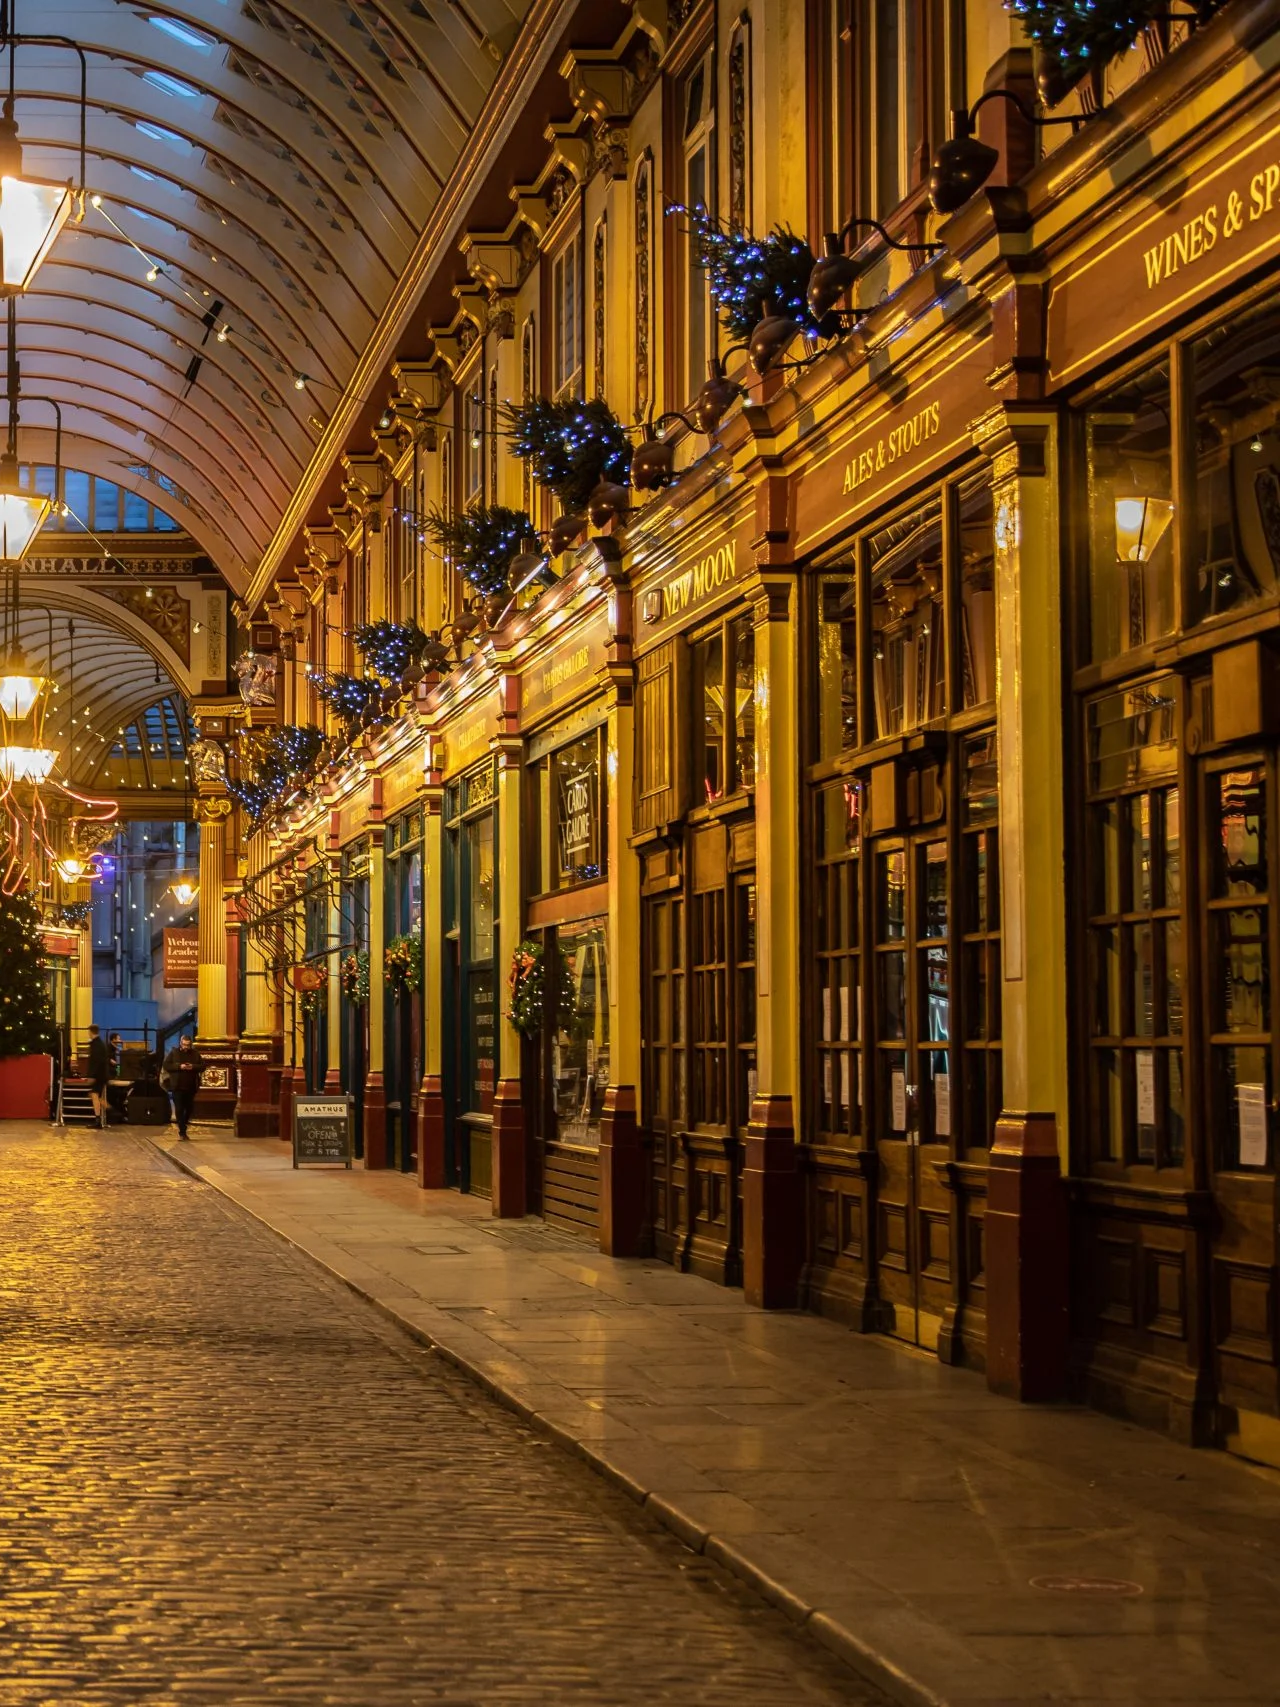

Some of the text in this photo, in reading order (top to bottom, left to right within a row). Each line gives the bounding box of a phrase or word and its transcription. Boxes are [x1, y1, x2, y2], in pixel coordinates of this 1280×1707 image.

[1143, 164, 1280, 289] WINES & SP
[842, 400, 940, 496] ALES & STOUTS
[663, 539, 736, 620] NEW MOON
[563, 645, 589, 680] GALORE
[567, 782, 588, 815] CARDS
[566, 812, 590, 844] GALORE
